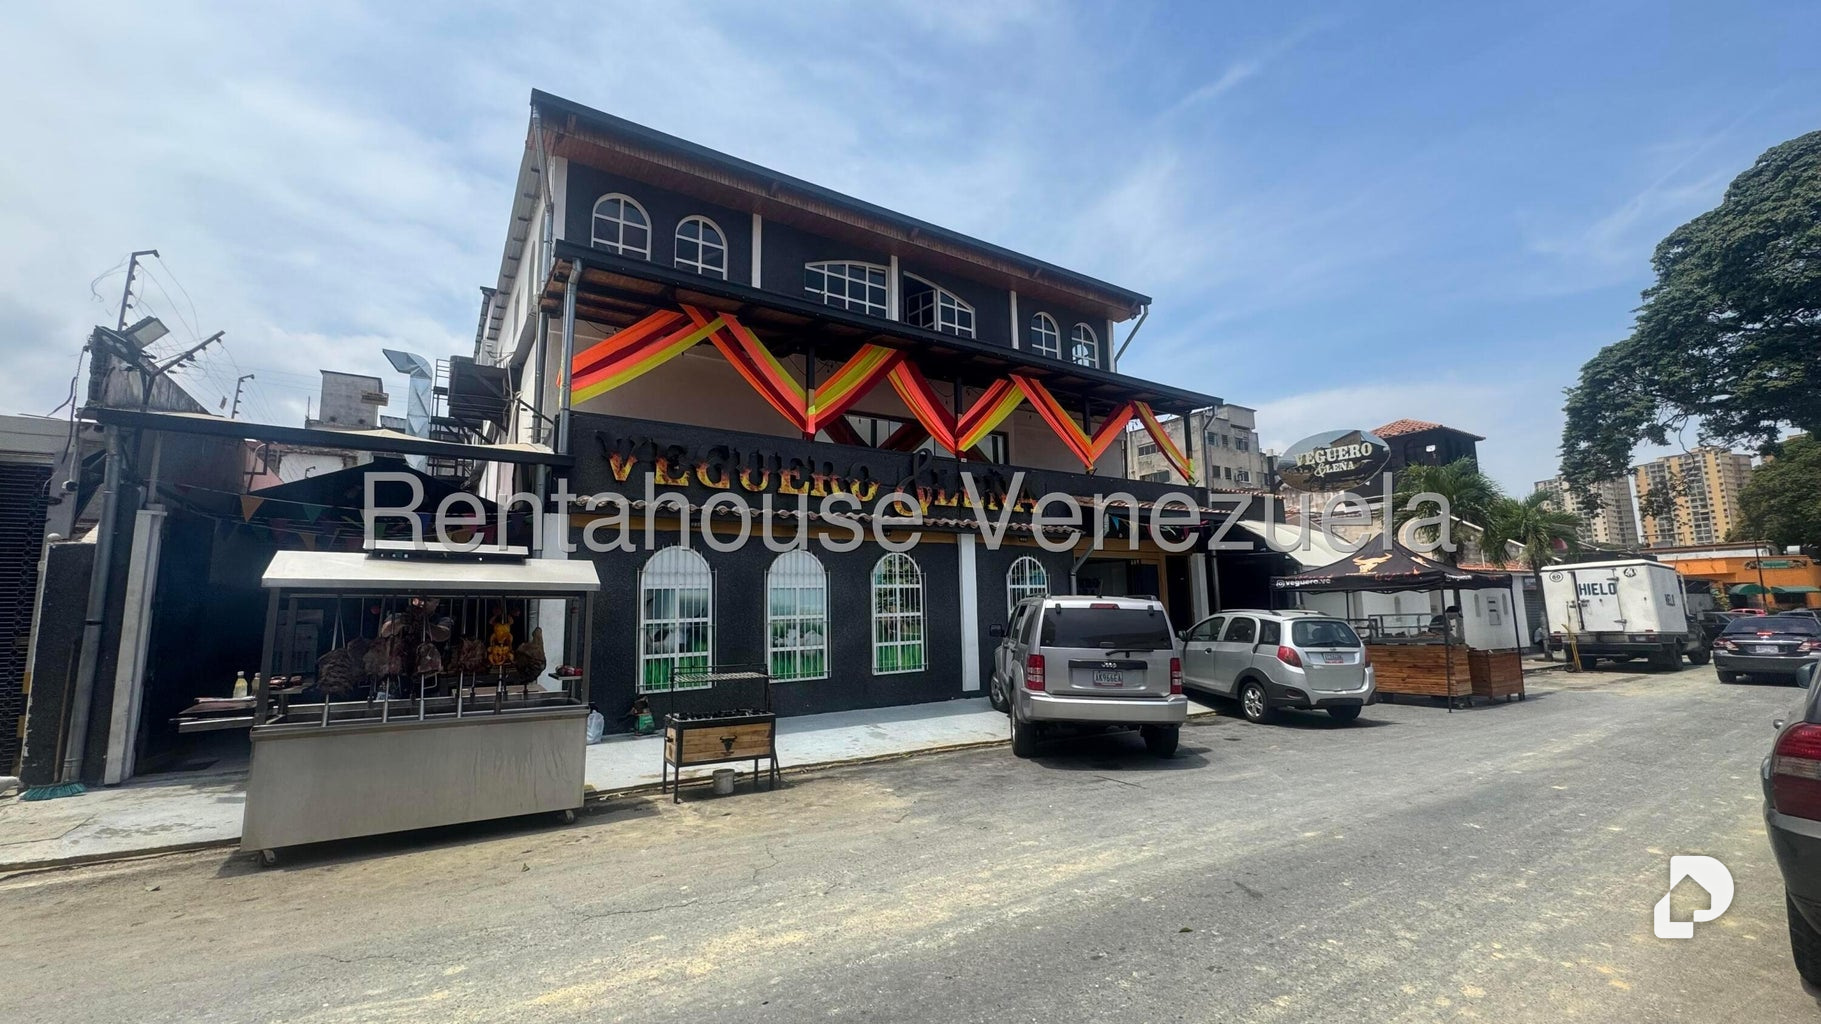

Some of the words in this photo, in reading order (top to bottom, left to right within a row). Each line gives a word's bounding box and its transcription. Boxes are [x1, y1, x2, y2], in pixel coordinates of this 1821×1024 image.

[597, 432, 884, 502] VEGUERO
[1294, 442, 1373, 467] VEGUERO
[1579, 583, 1617, 595] HIELO
